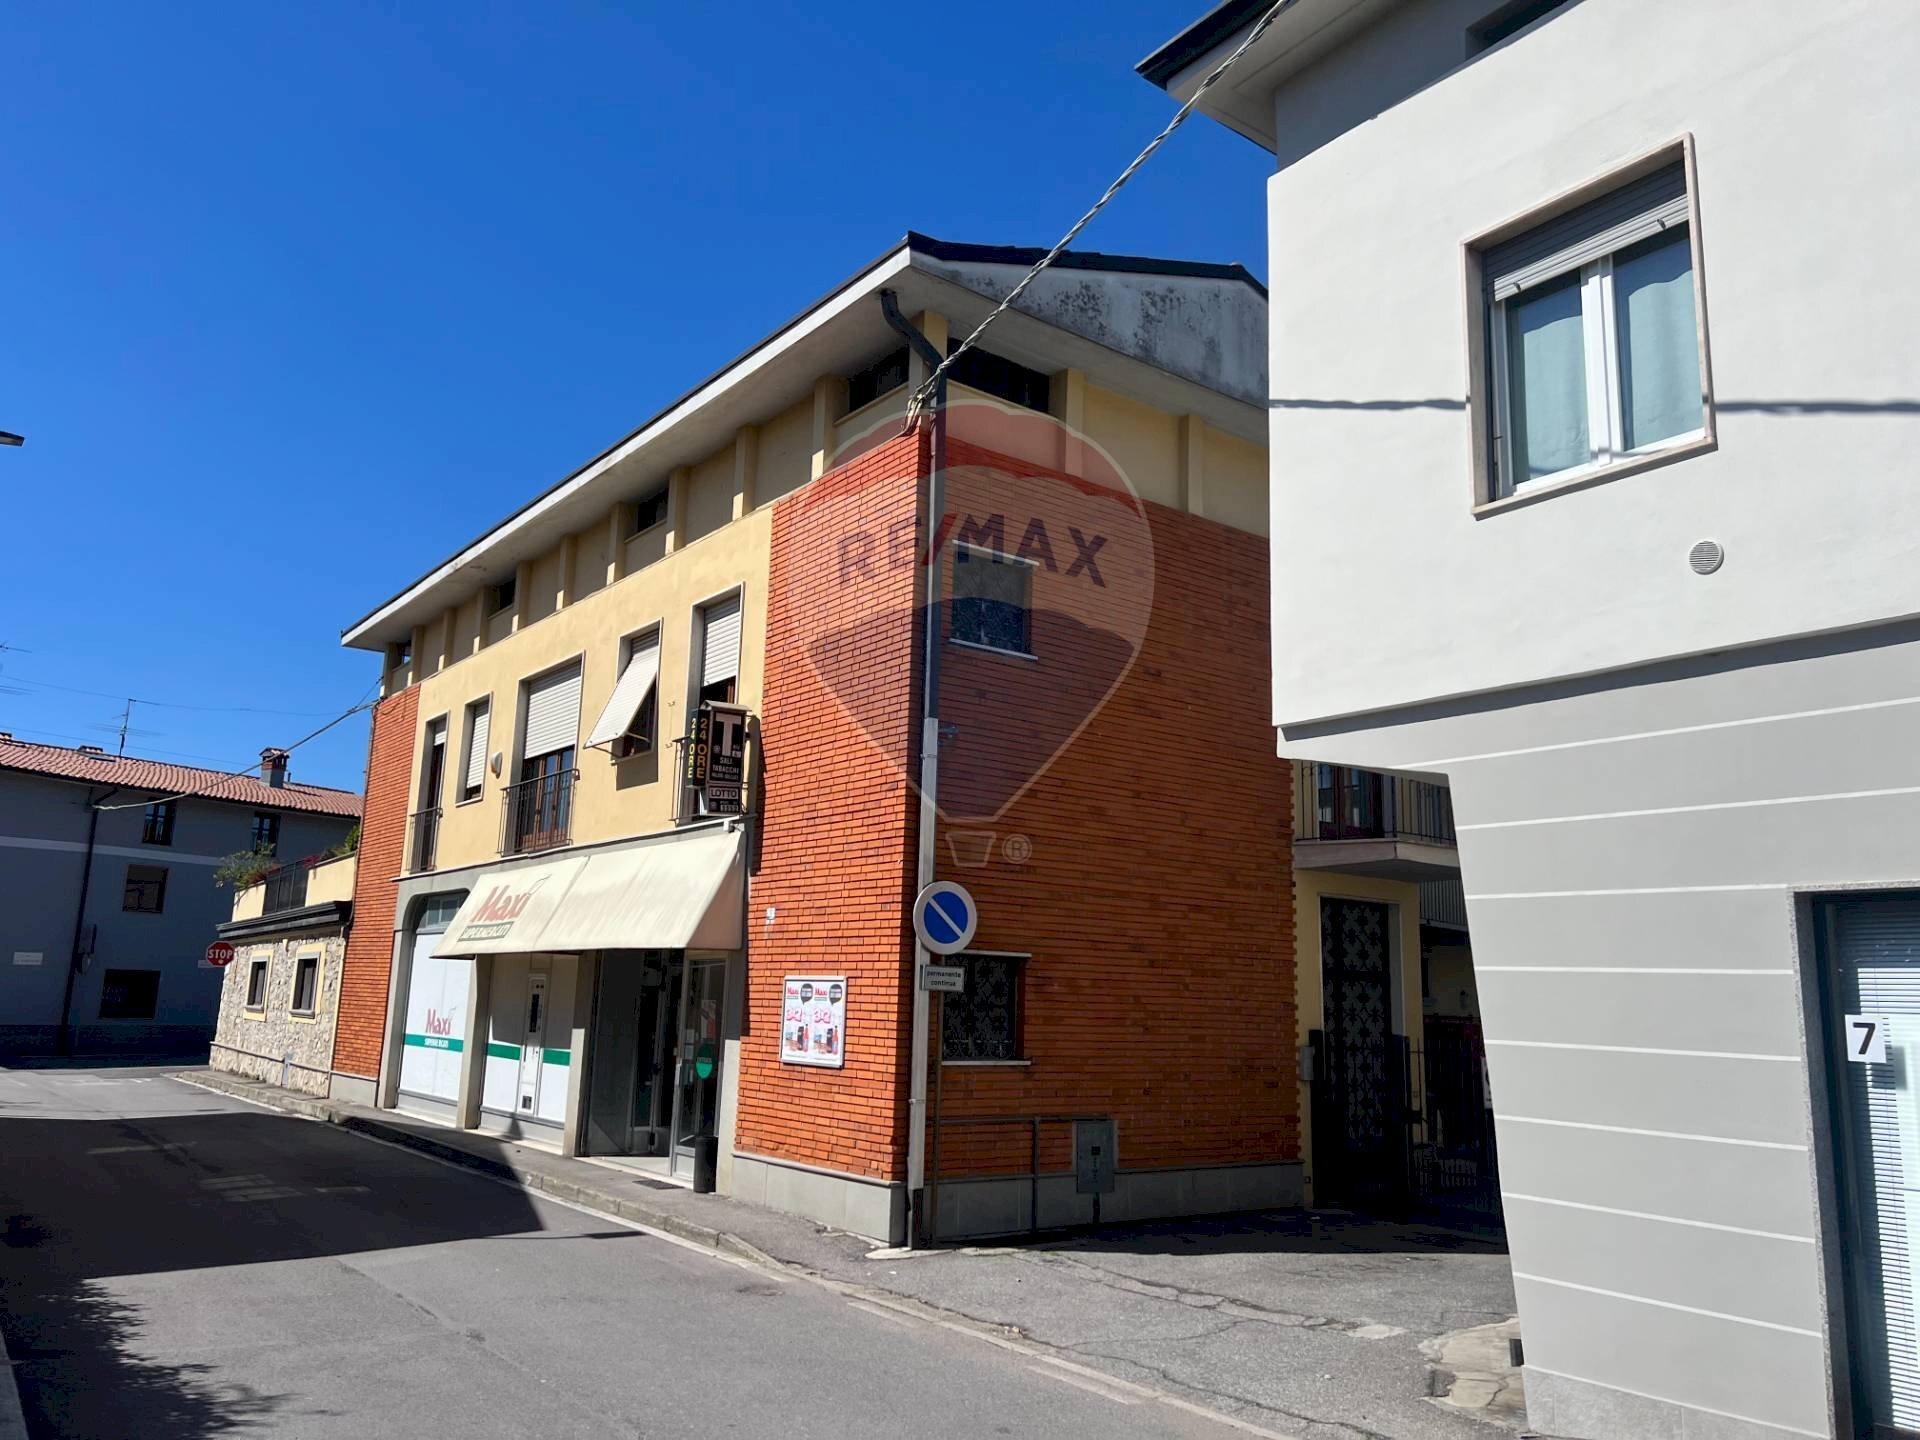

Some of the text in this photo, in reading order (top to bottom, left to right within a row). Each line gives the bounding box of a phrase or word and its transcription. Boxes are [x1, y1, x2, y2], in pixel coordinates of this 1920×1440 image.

[710, 788, 737, 798] LOTTO
[470, 884, 531, 923] Maxi
[208, 949, 233, 959] STOP
[926, 970, 961, 978] permanente
[930, 979, 956, 987] continua
[425, 1008, 451, 1036] Maxi
[1852, 1022, 1876, 1055] 7
